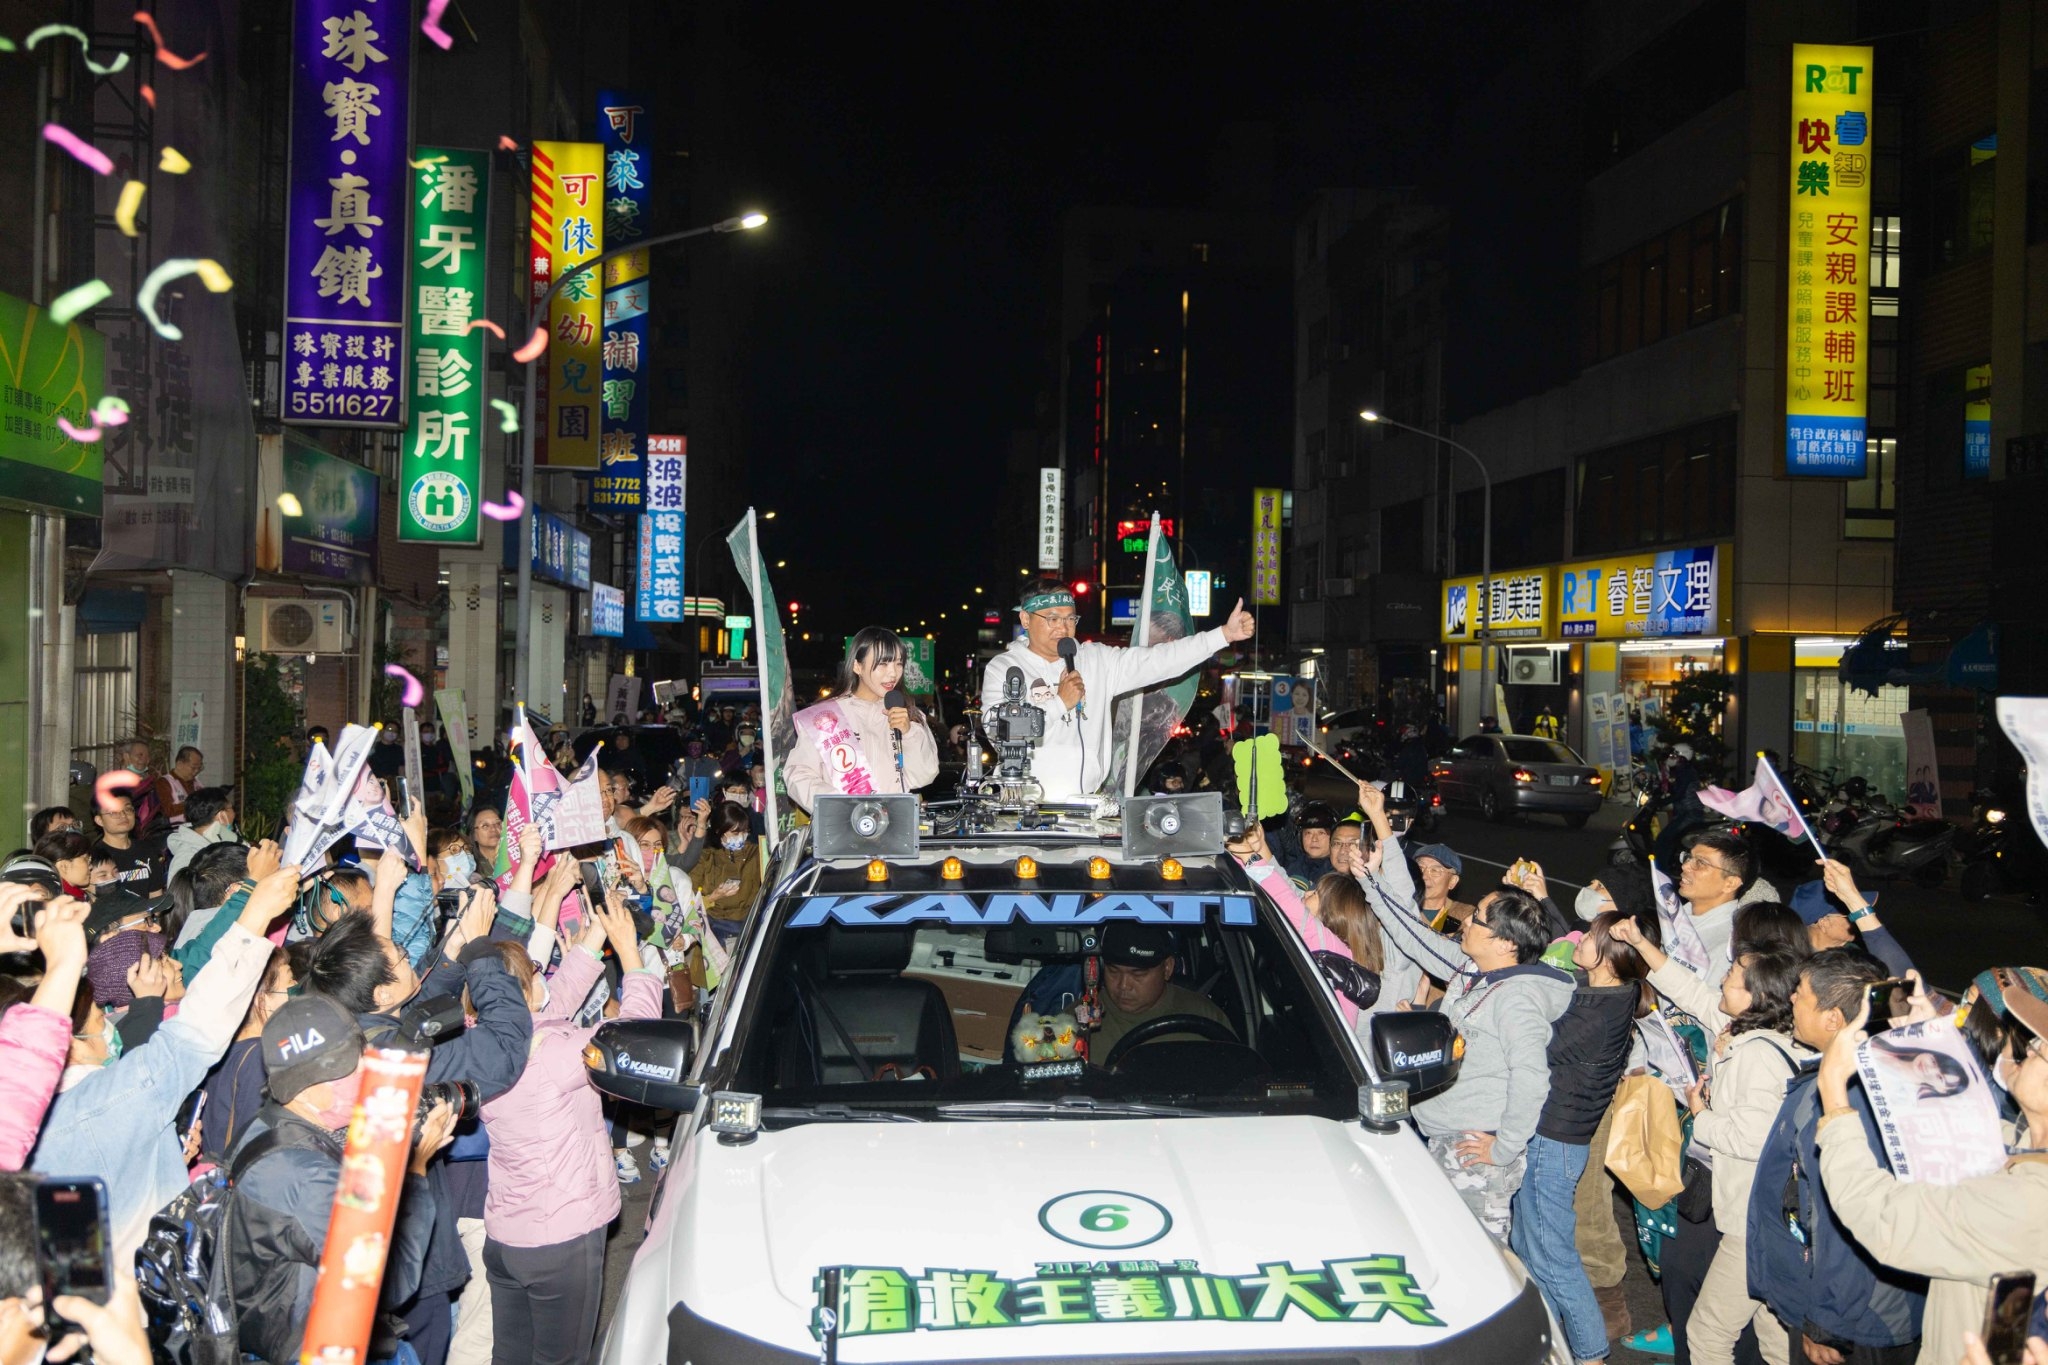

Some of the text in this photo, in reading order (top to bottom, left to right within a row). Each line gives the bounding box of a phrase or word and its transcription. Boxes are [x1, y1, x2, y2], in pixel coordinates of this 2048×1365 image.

[1797, 118, 1831, 196] 快樂
[1834, 110, 1868, 188] 睿智
[413, 157, 479, 460] 潘牙醫診所
[1823, 212, 1859, 402] 安親課輔班
[293, 331, 395, 361] 珠寶設計
[292, 361, 394, 390] 專業服務
[292, 391, 394, 417] 5511627
[602, 330, 641, 466] 補習班
[647, 438, 682, 453] 24H
[654, 457, 682, 509] 波波
[654, 513, 682, 619] 投幣式洗衣
[1607, 560, 1712, 617] 睿智文理
[836, 748, 853, 769] 2
[785, 893, 1257, 928] KANATI
[277, 1027, 326, 1060] FILA
[1408, 1049, 1442, 1065] KANATI
[629, 1060, 675, 1077] KANATI
[1078, 1203, 1132, 1232] 6
[1036, 1260, 1198, 1275] 2024 團結一致
[812, 1255, 1448, 1336] 搶救王義川大兵
